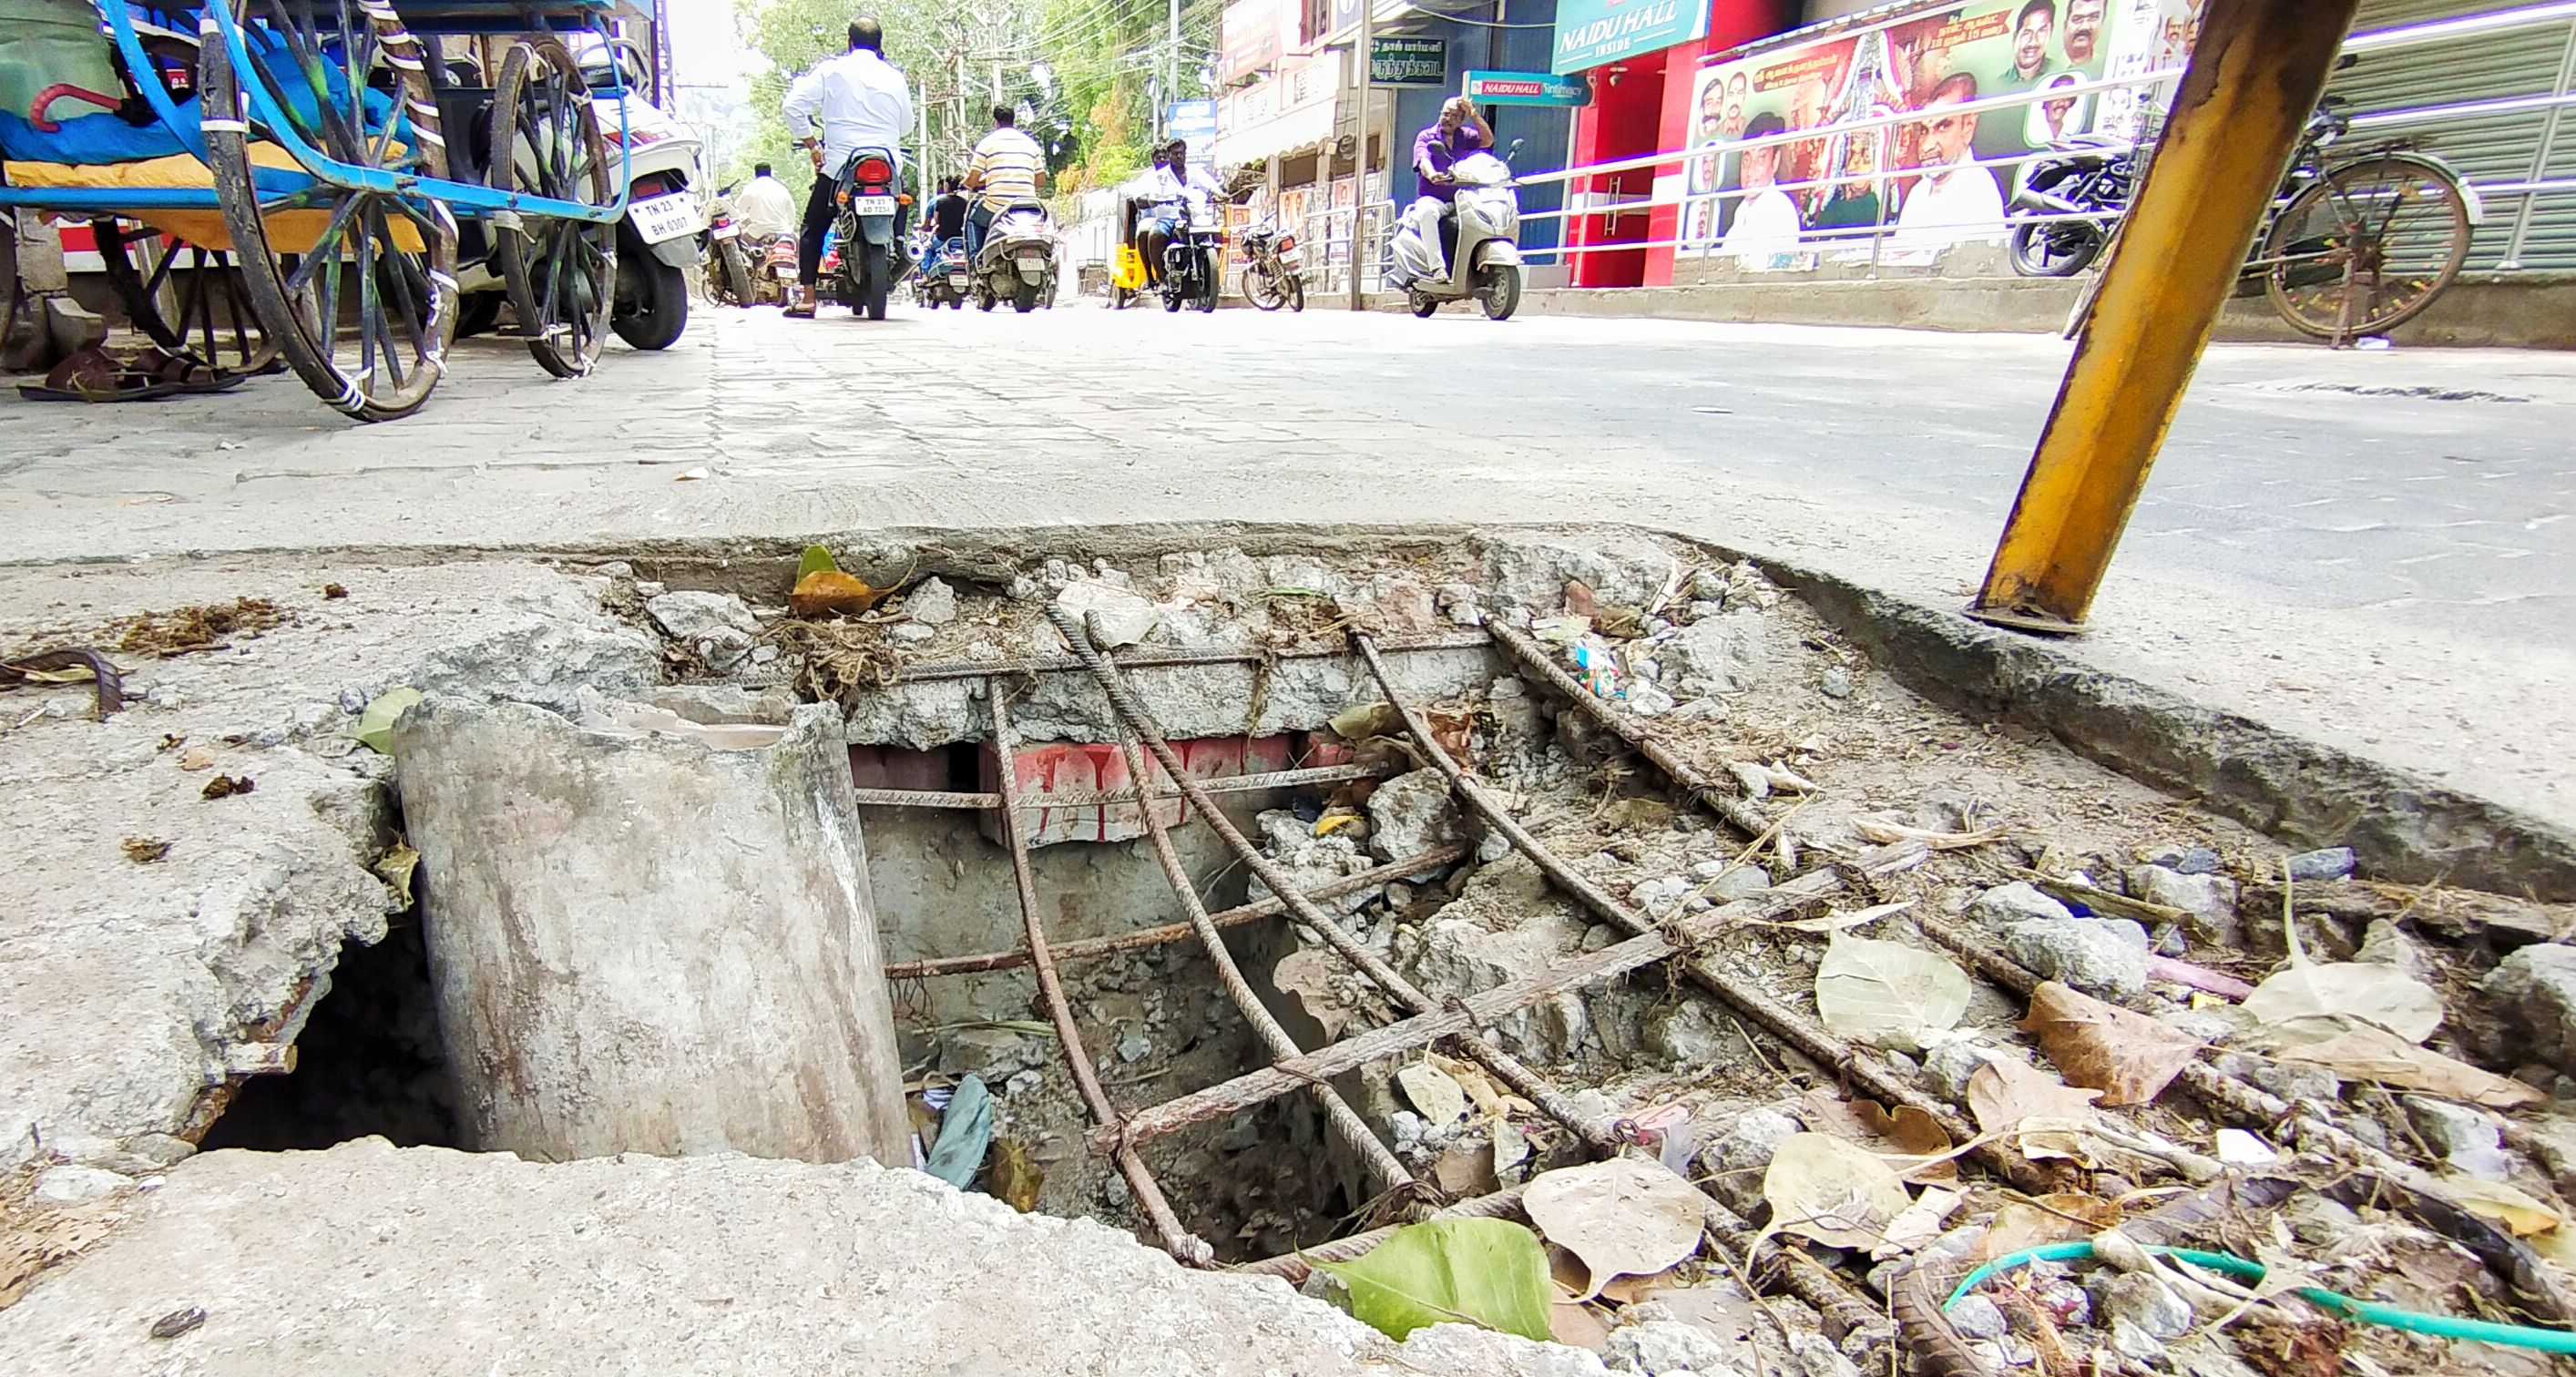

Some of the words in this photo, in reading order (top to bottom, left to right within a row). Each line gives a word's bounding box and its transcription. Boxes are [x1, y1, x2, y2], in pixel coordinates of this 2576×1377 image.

[1559, 15, 1621, 54] NAIDU
[1621, 1, 1678, 36] HALL
[1595, 37, 1630, 57] INSIDE
[1484, 83, 1515, 93] NAIDU
[1514, 84, 1539, 94] HALL
[645, 203, 661, 216] TN
[660, 200, 674, 212] 23
[650, 222, 667, 236] BH
[667, 217, 689, 231] 0307
